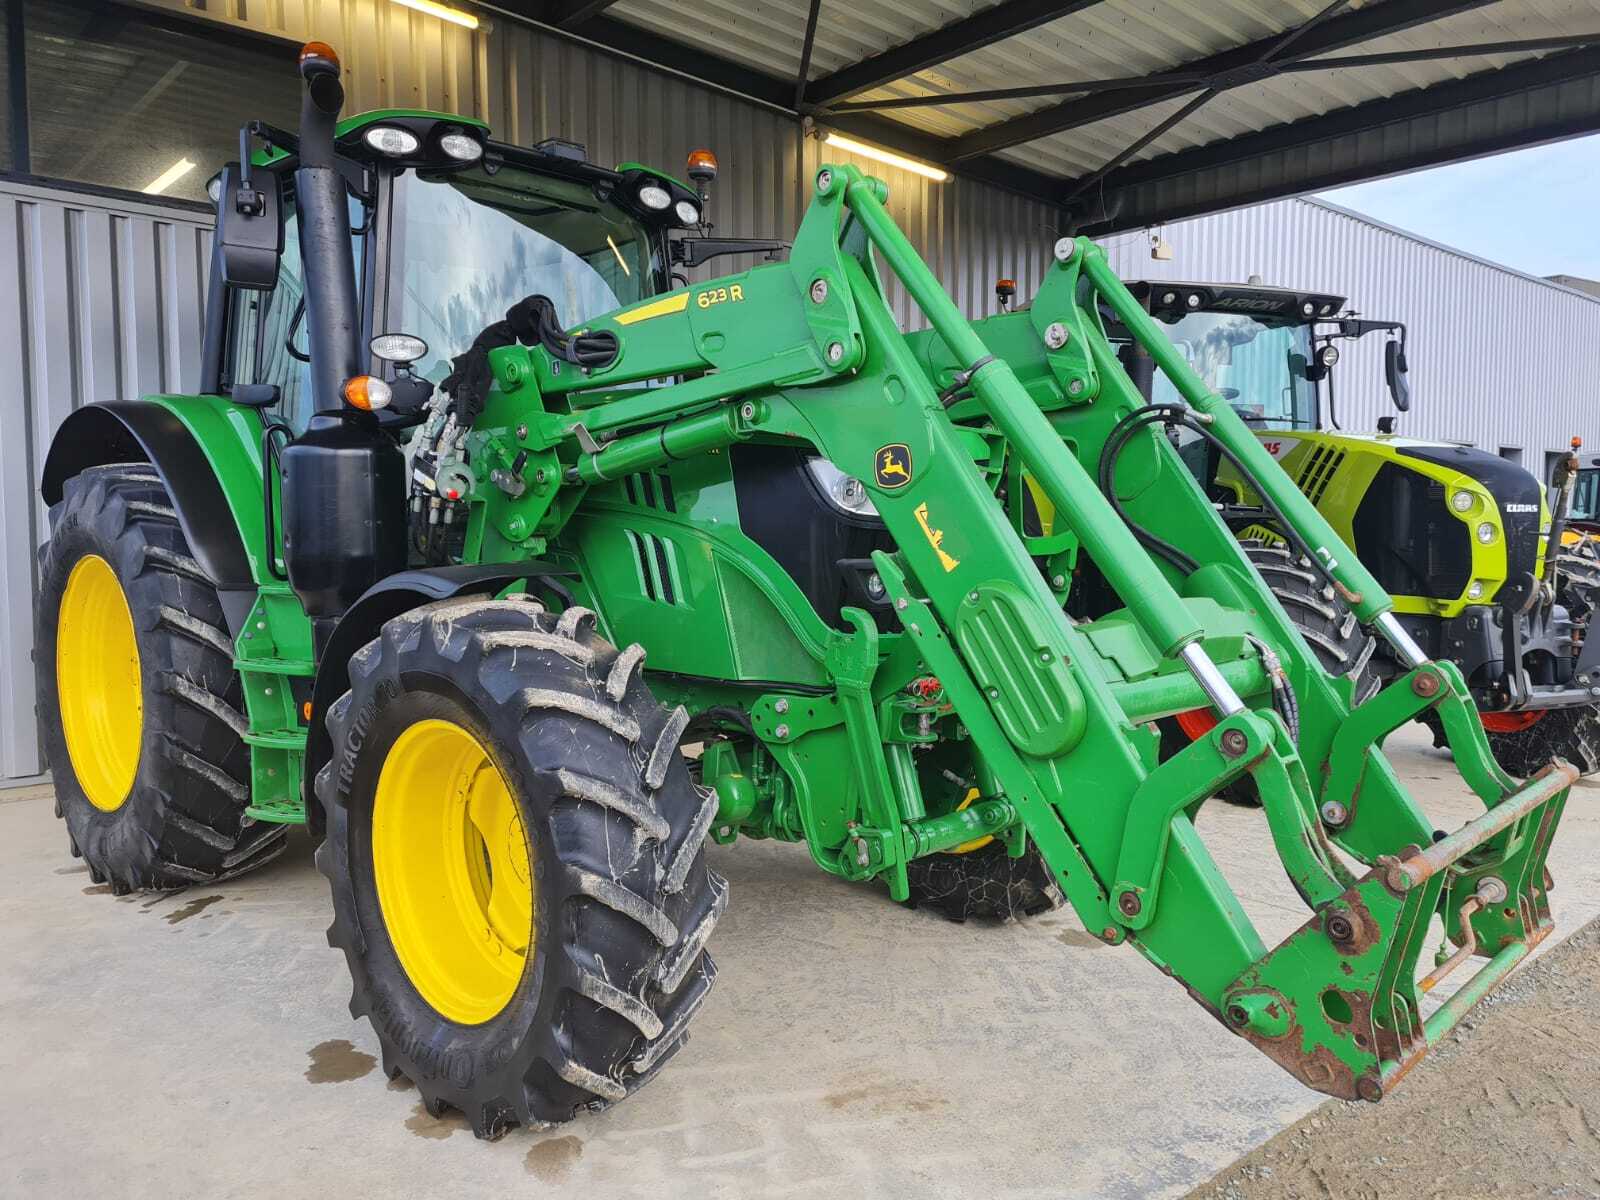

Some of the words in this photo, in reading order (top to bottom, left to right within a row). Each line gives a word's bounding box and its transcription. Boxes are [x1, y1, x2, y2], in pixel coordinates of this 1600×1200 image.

[697, 288, 728, 309] 623
[729, 284, 744, 302] R
[1214, 298, 1285, 312] ARION
[1506, 504, 1538, 513] CLAAS
